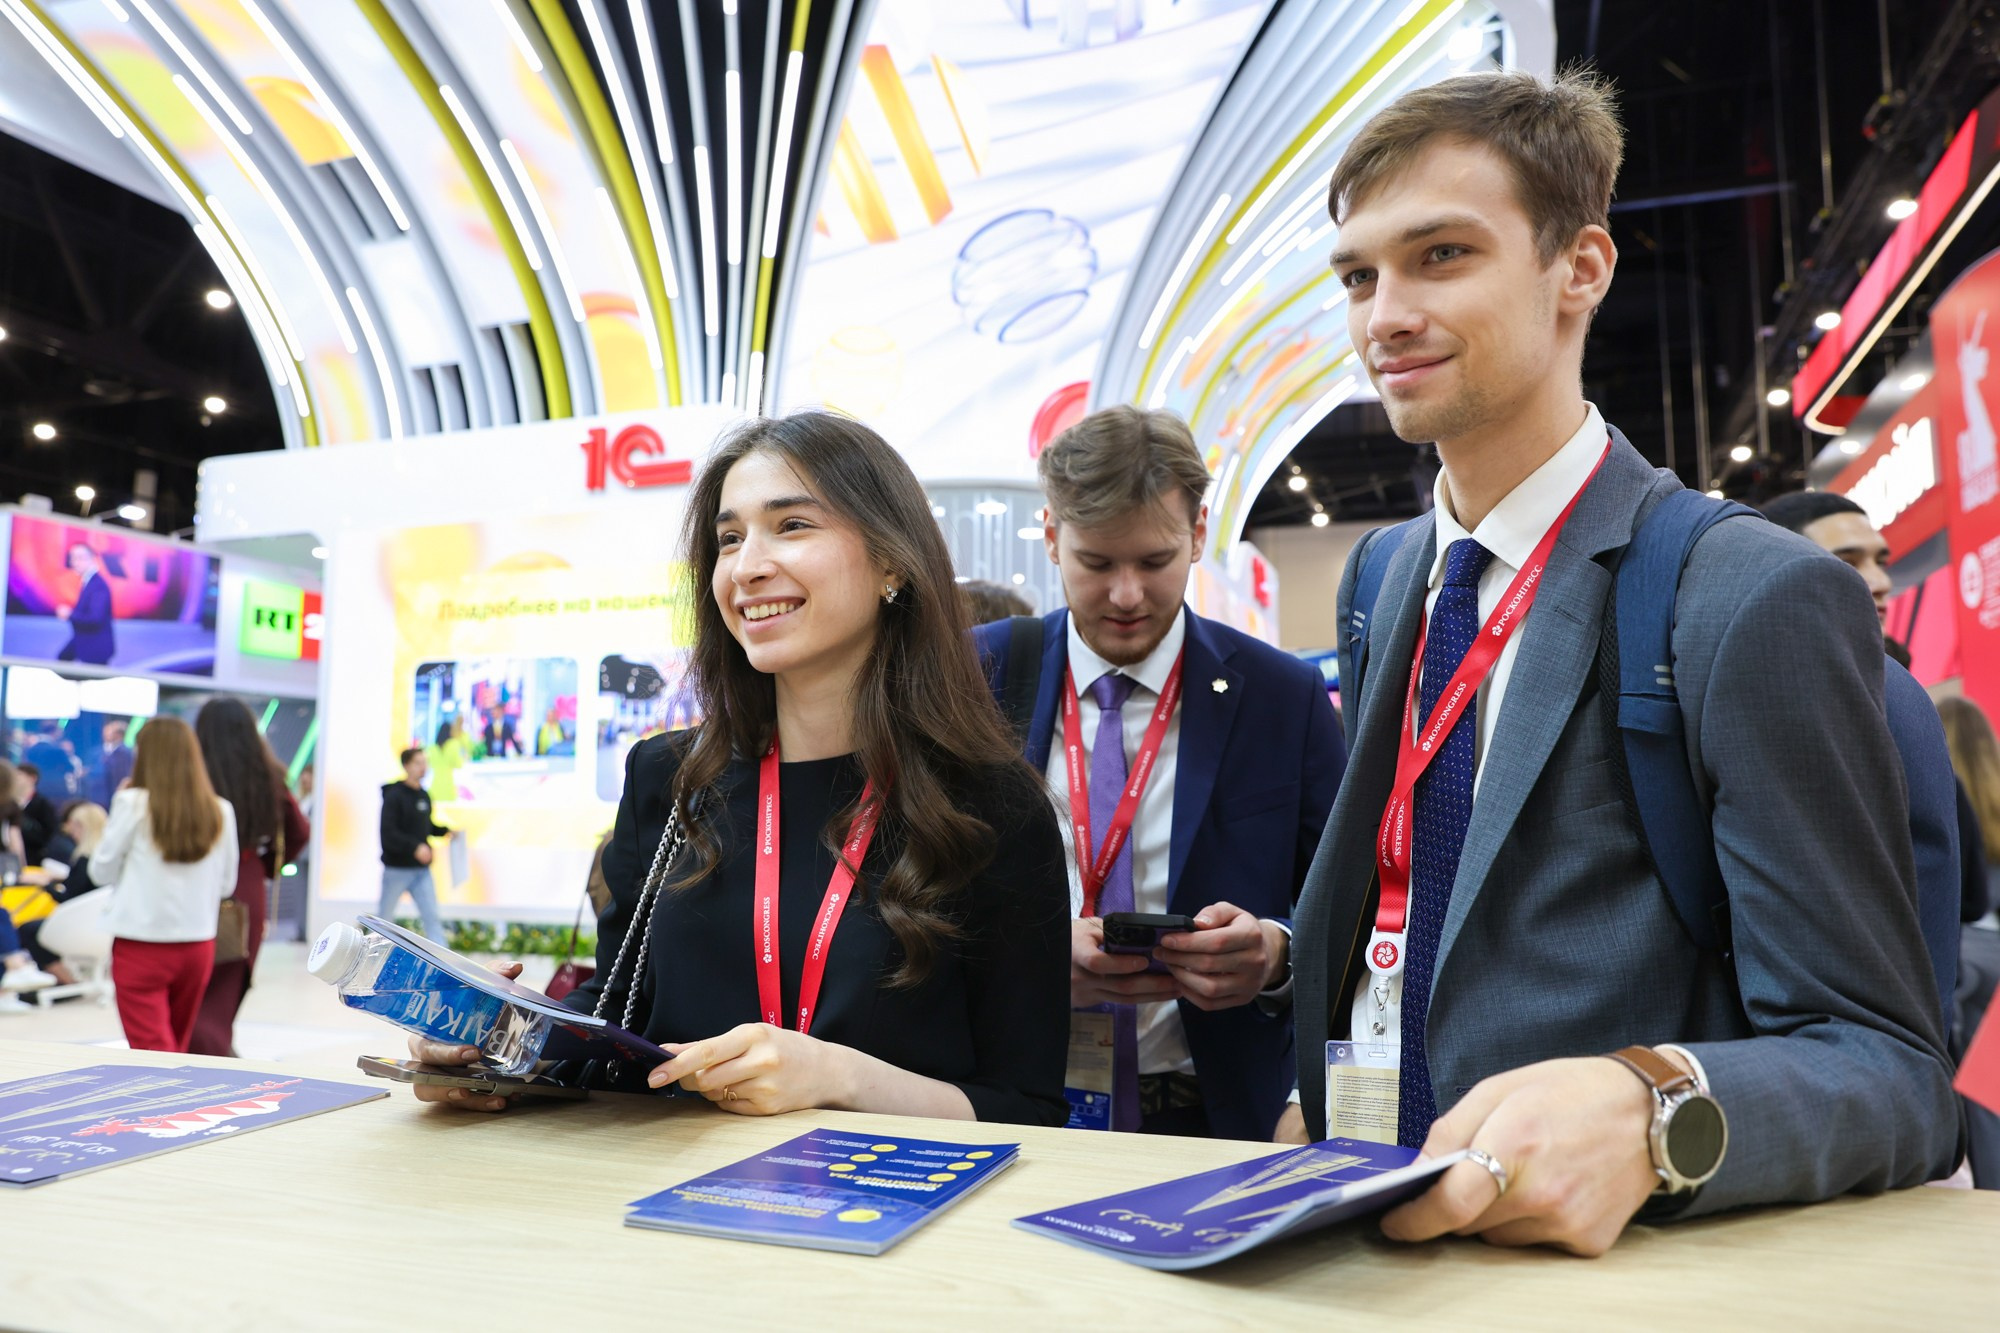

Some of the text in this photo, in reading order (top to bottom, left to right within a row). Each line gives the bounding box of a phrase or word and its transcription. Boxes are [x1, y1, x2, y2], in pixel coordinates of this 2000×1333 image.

[254, 607, 295, 631] RT
[563, 598, 591, 614] на
[1498, 564, 1543, 627] РОСКОНГРЕСС
[1428, 681, 1467, 743] ROSCONGRESS
[765, 794, 773, 846] РОСКОНГРЕСС
[1382, 796, 1398, 860] РОСКОНГРЕСС
[1394, 801, 1406, 857] SCONGRESS
[812, 902, 836, 960] РОСКОНГРЕСС
[410, 992, 510, 1055] BAIKAL
